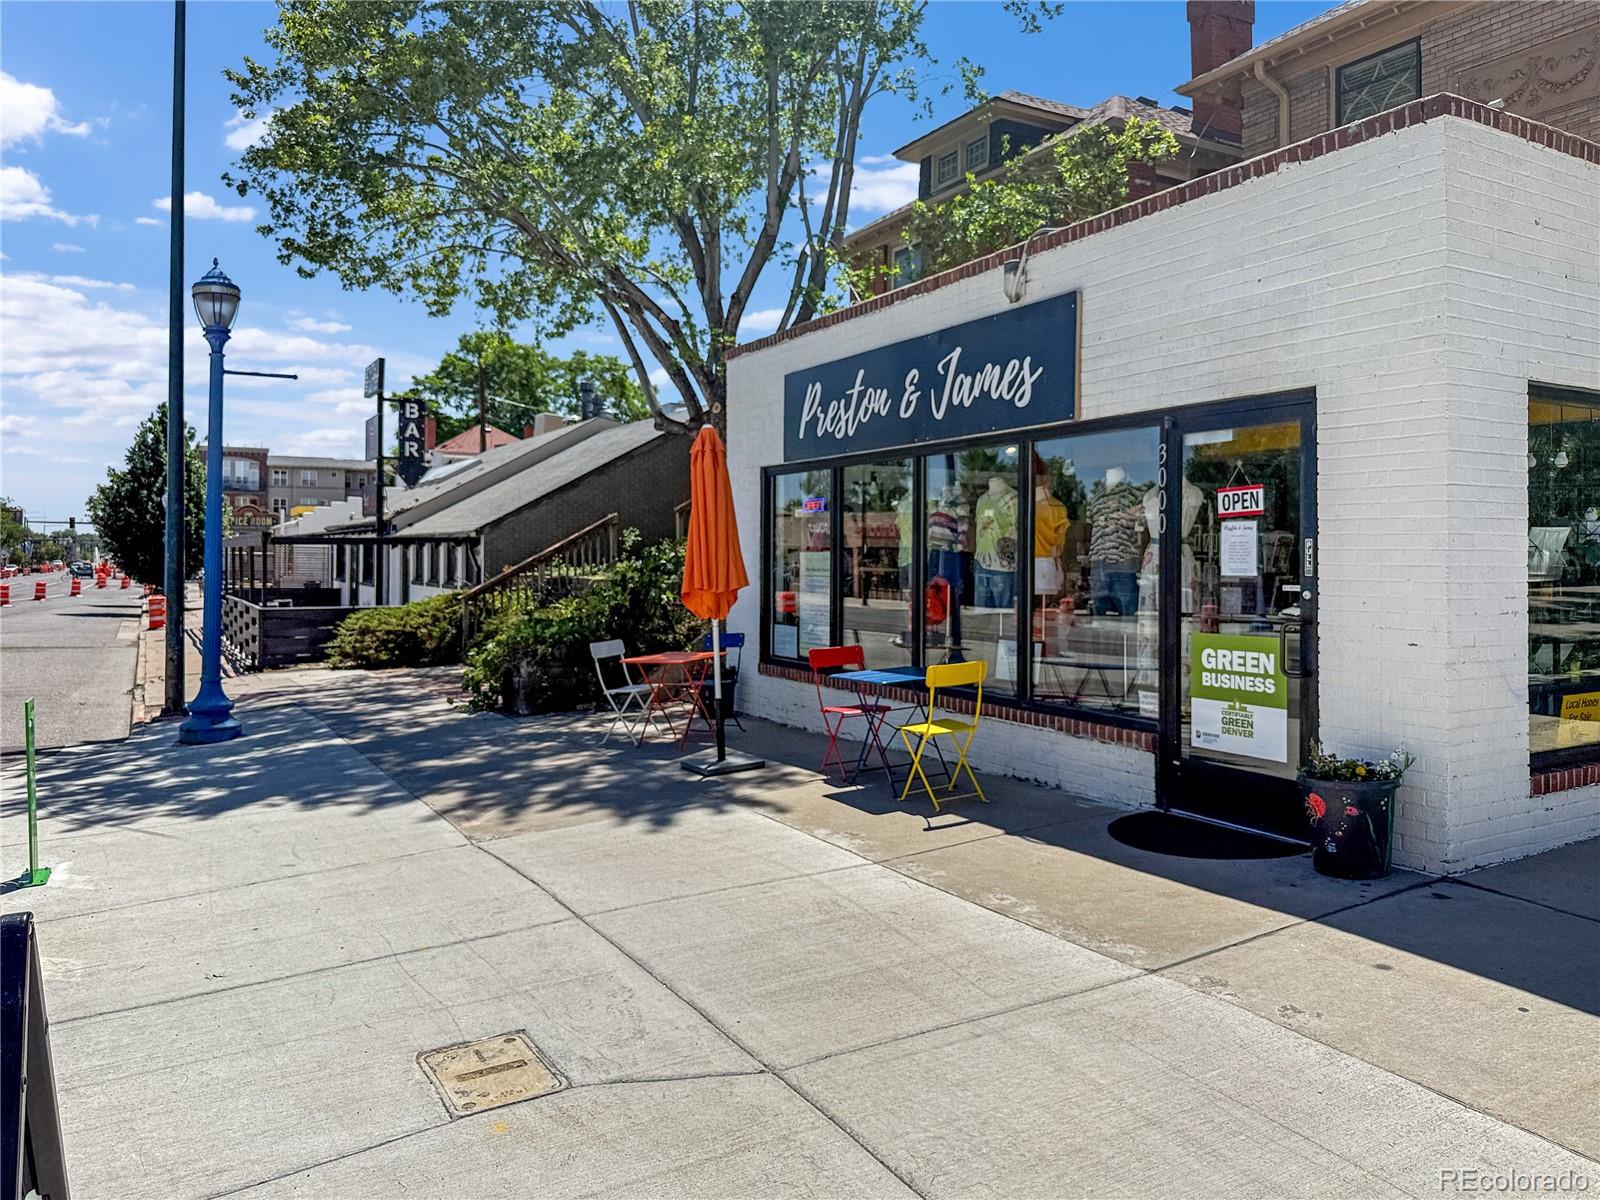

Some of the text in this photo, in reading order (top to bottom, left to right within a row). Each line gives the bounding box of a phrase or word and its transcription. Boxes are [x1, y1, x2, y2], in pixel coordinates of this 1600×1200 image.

[799, 346, 1044, 440] Preston & James
[404, 402, 420, 458] BAR
[1158, 443, 1167, 534] 3000
[1222, 491, 1259, 511] OPEN
[1201, 648, 1275, 675] GREEN
[1201, 671, 1276, 694] BUSINESS
[1565, 698, 1581, 710] Local
[1221, 716, 1254, 730] GREEN
[1221, 726, 1254, 739] DENVER
